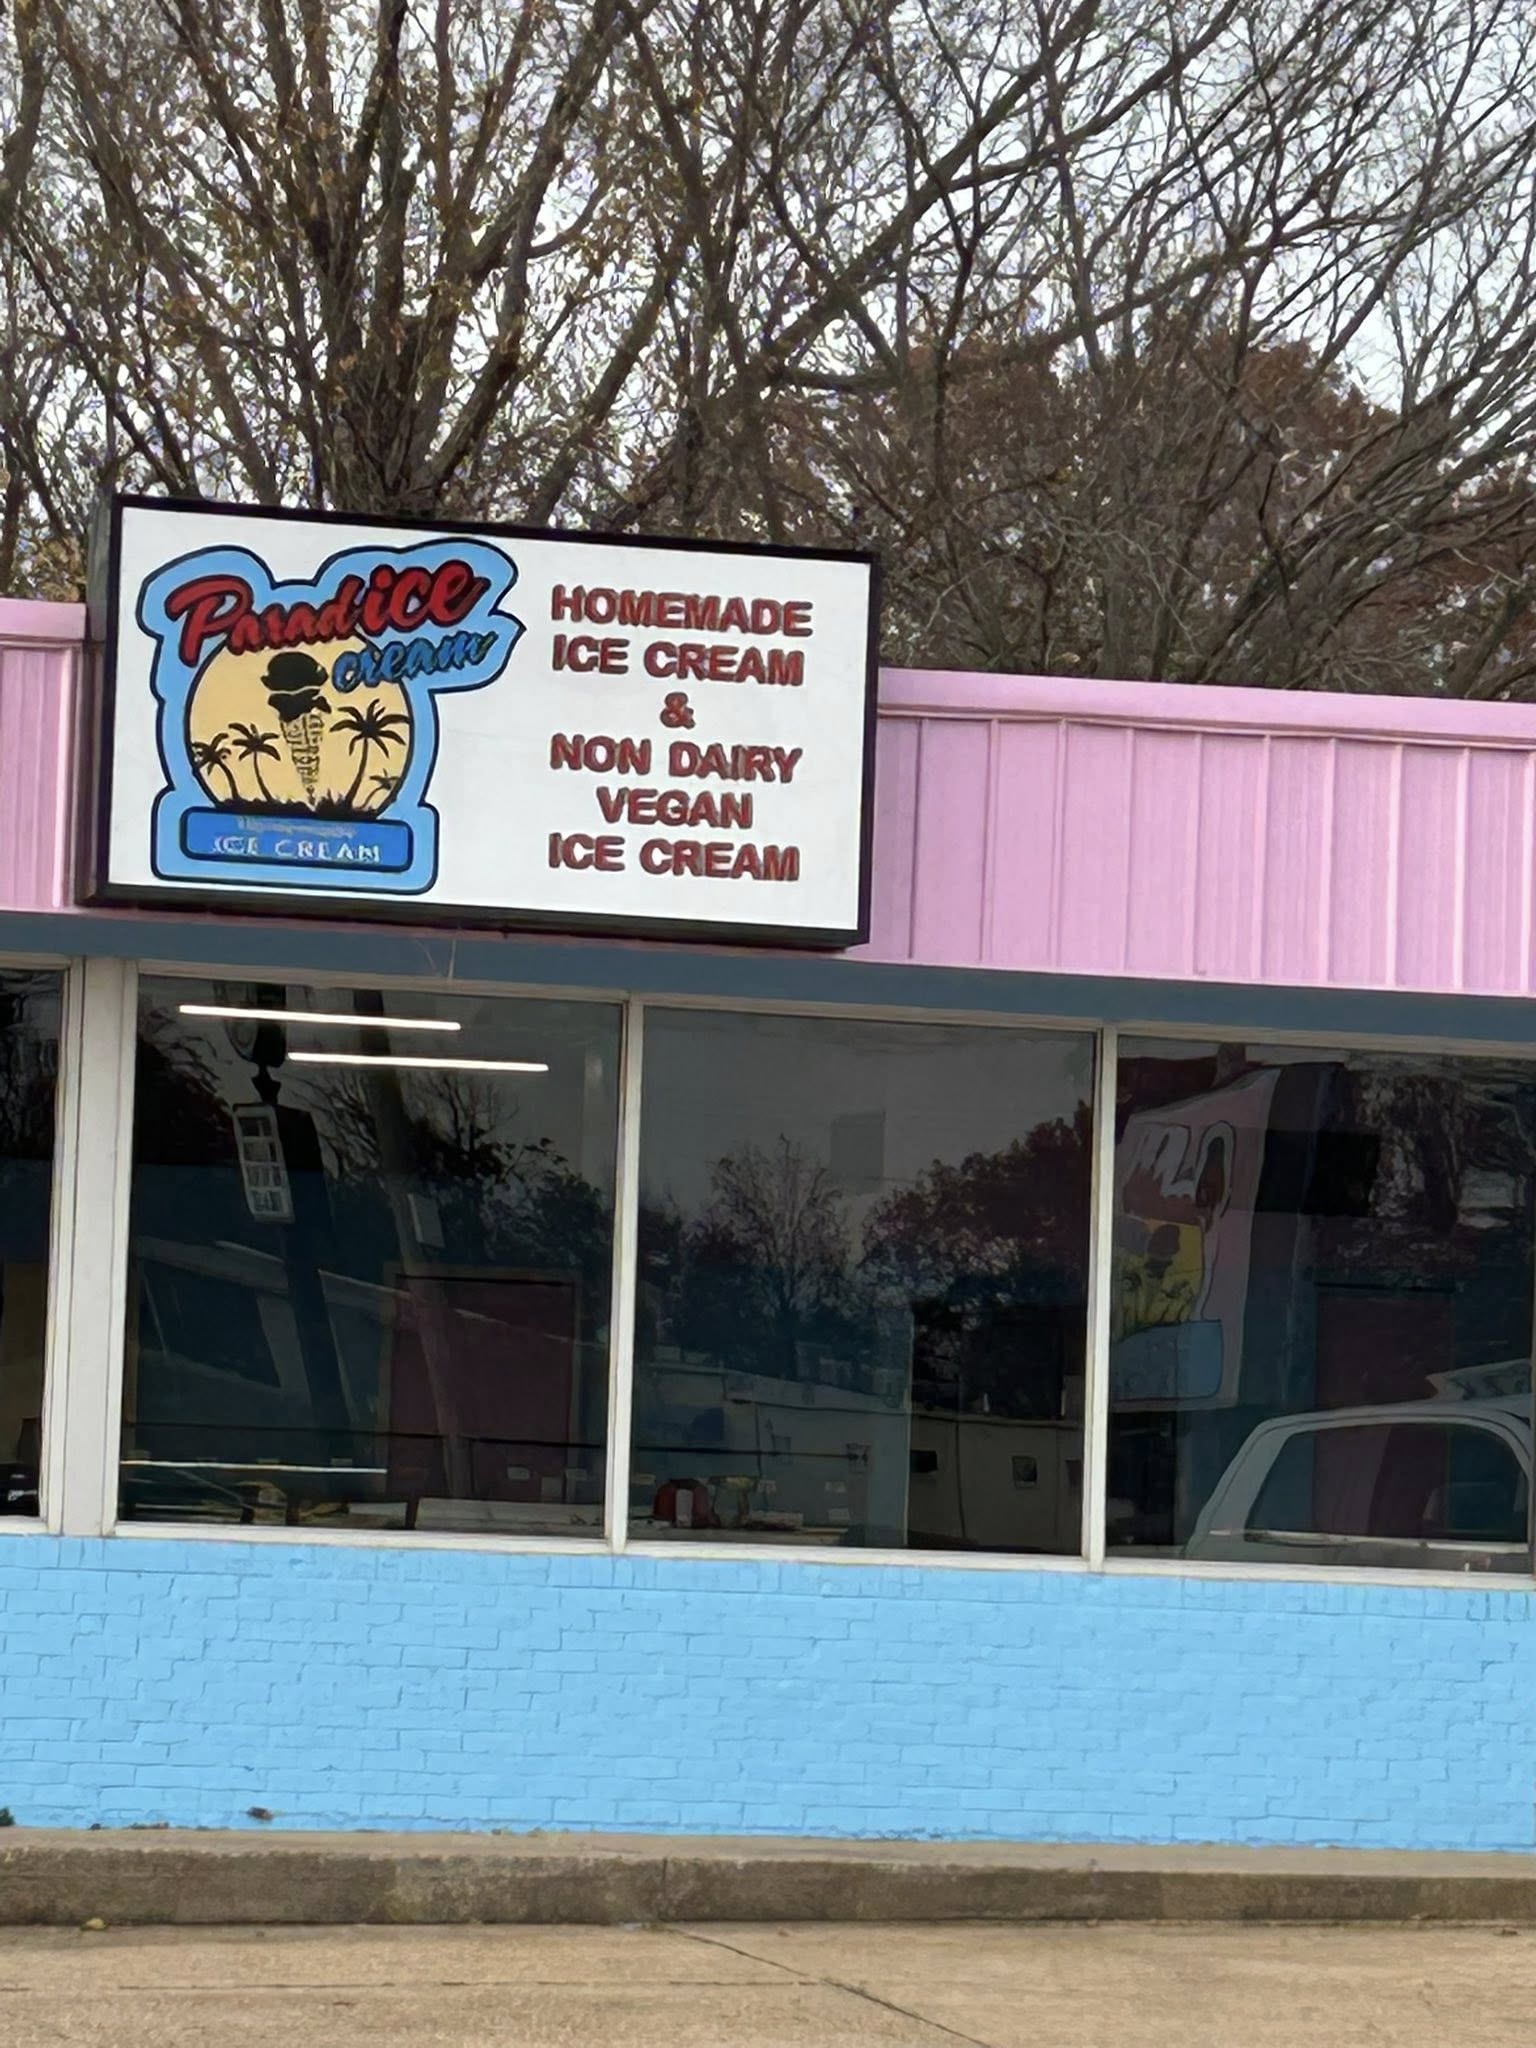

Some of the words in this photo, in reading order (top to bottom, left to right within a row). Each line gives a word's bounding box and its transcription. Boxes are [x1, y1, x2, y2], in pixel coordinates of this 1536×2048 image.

[551, 584, 813, 637] HOMEMADE
[552, 634, 630, 675] ICE
[643, 640, 805, 686] CREAM
[659, 691, 696, 729] &
[549, 733, 651, 776] NON
[668, 740, 803, 784] DAIRY
[596, 786, 753, 830] VEGAN
[549, 832, 625, 872] ICE
[639, 838, 800, 882] CREAM
